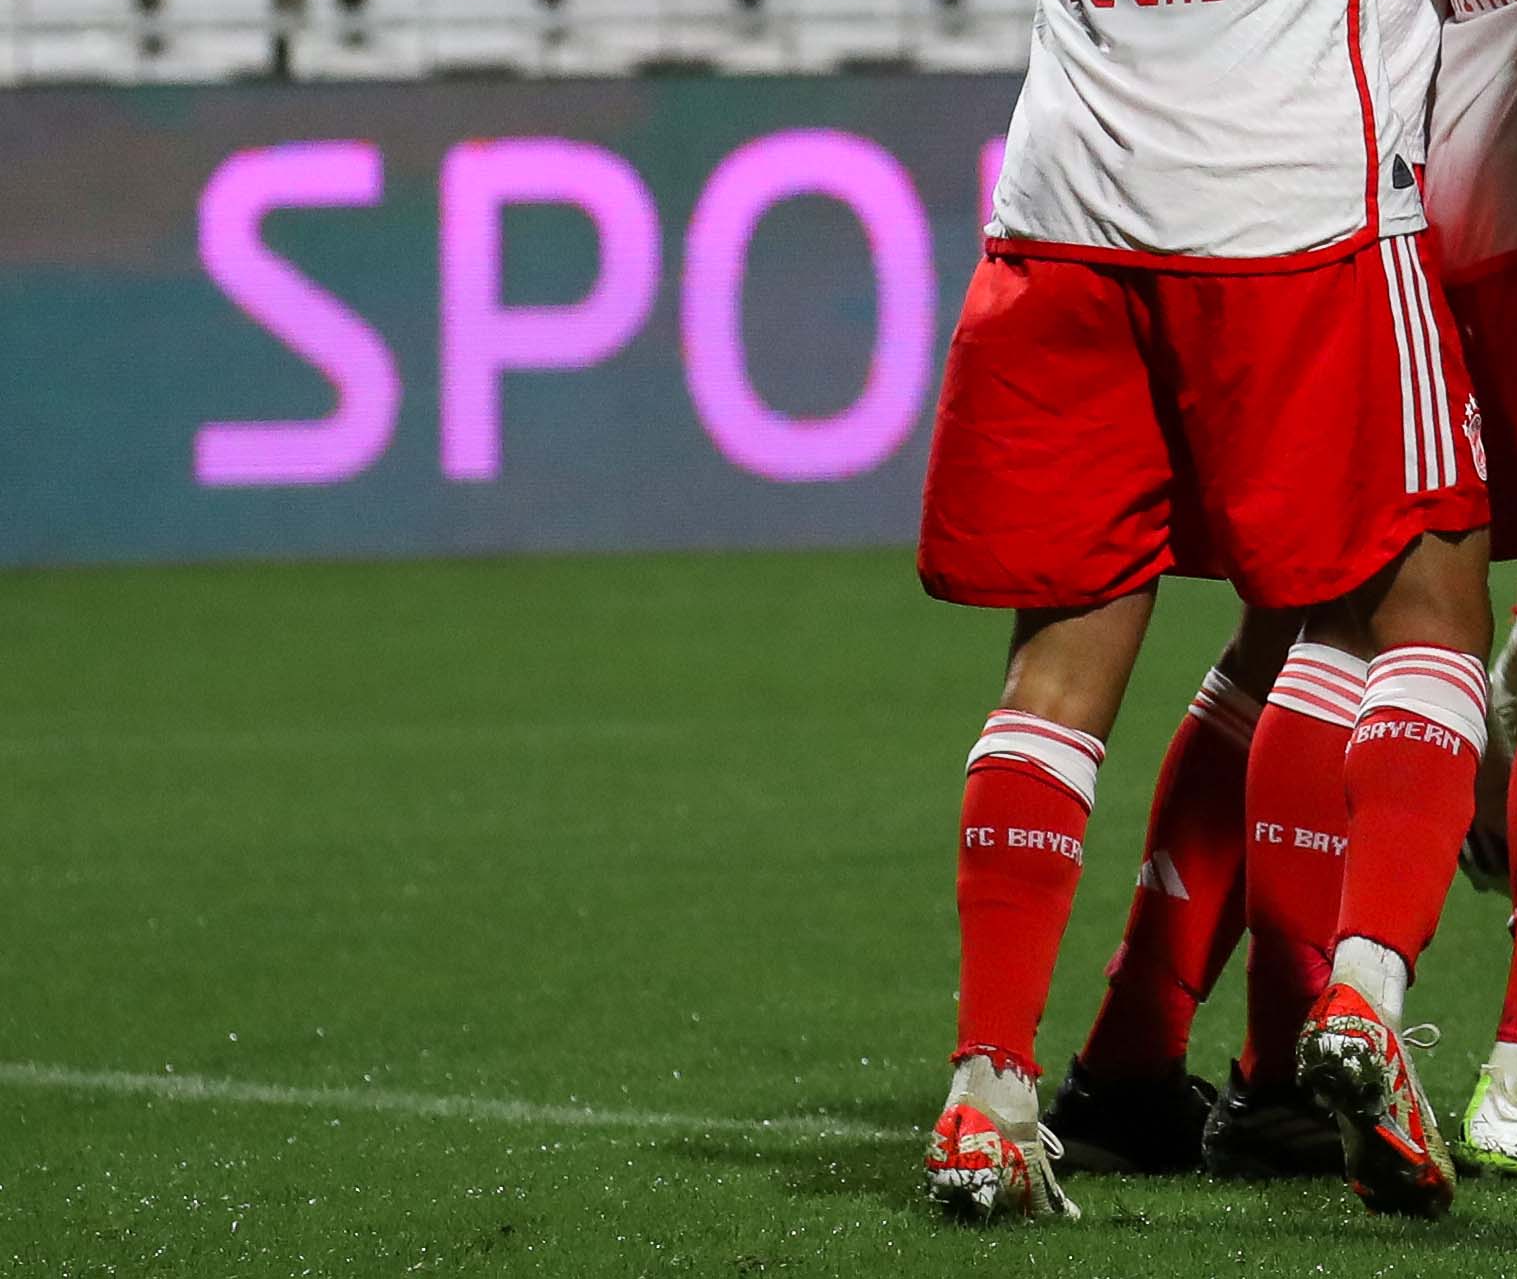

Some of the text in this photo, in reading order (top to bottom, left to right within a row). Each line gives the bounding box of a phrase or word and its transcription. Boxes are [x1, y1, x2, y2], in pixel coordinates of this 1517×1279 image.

[1356, 720, 1462, 757] BAYERN
[964, 826, 996, 849] FC
[1254, 820, 1285, 844] FC
